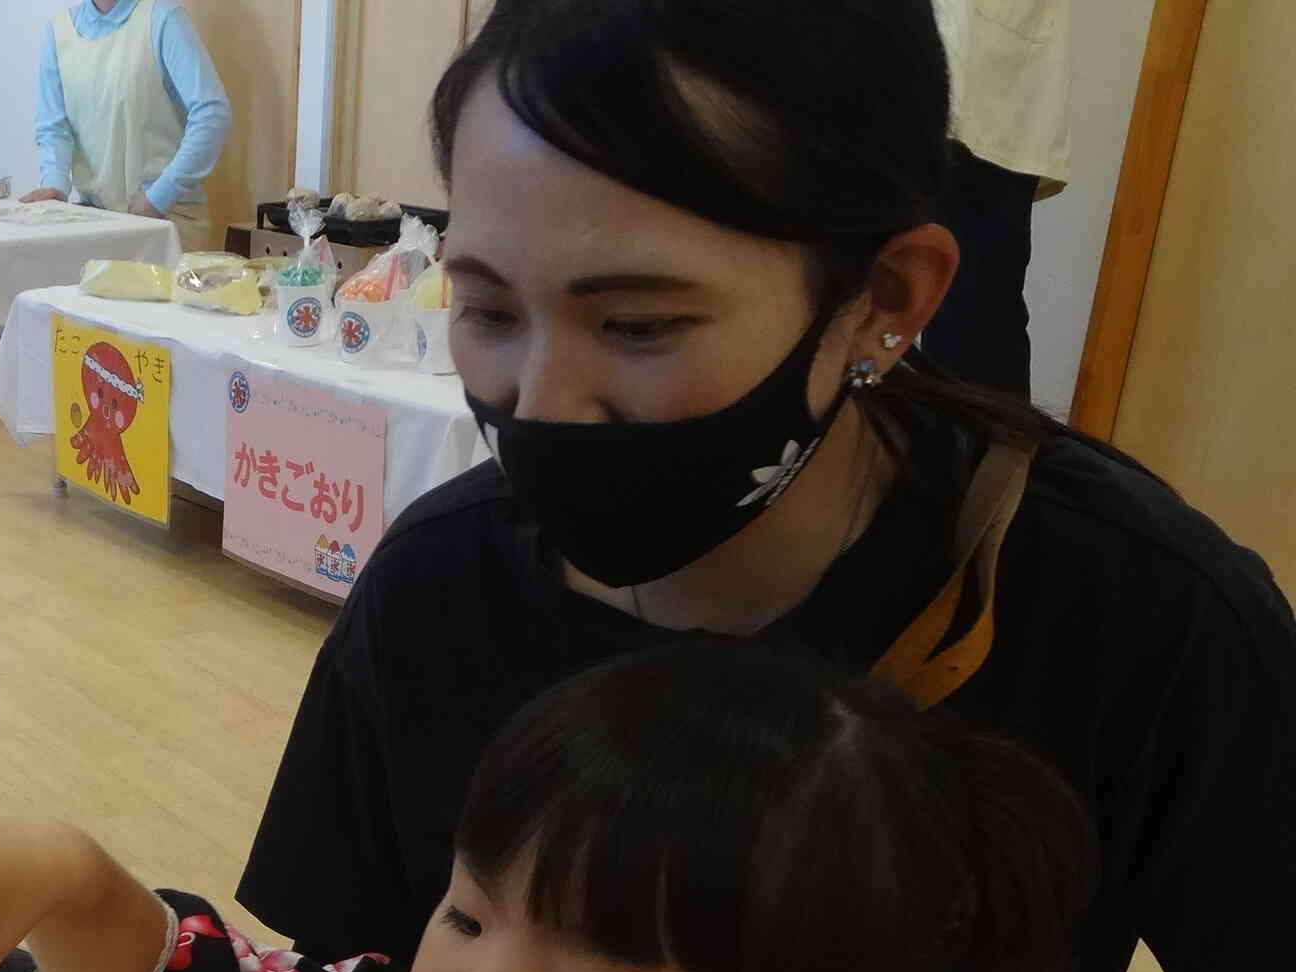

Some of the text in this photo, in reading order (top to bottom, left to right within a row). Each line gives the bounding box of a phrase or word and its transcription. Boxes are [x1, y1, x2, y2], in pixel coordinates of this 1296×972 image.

[54, 324, 166, 384] たこ やき
[233, 441, 365, 533] かきごおり
